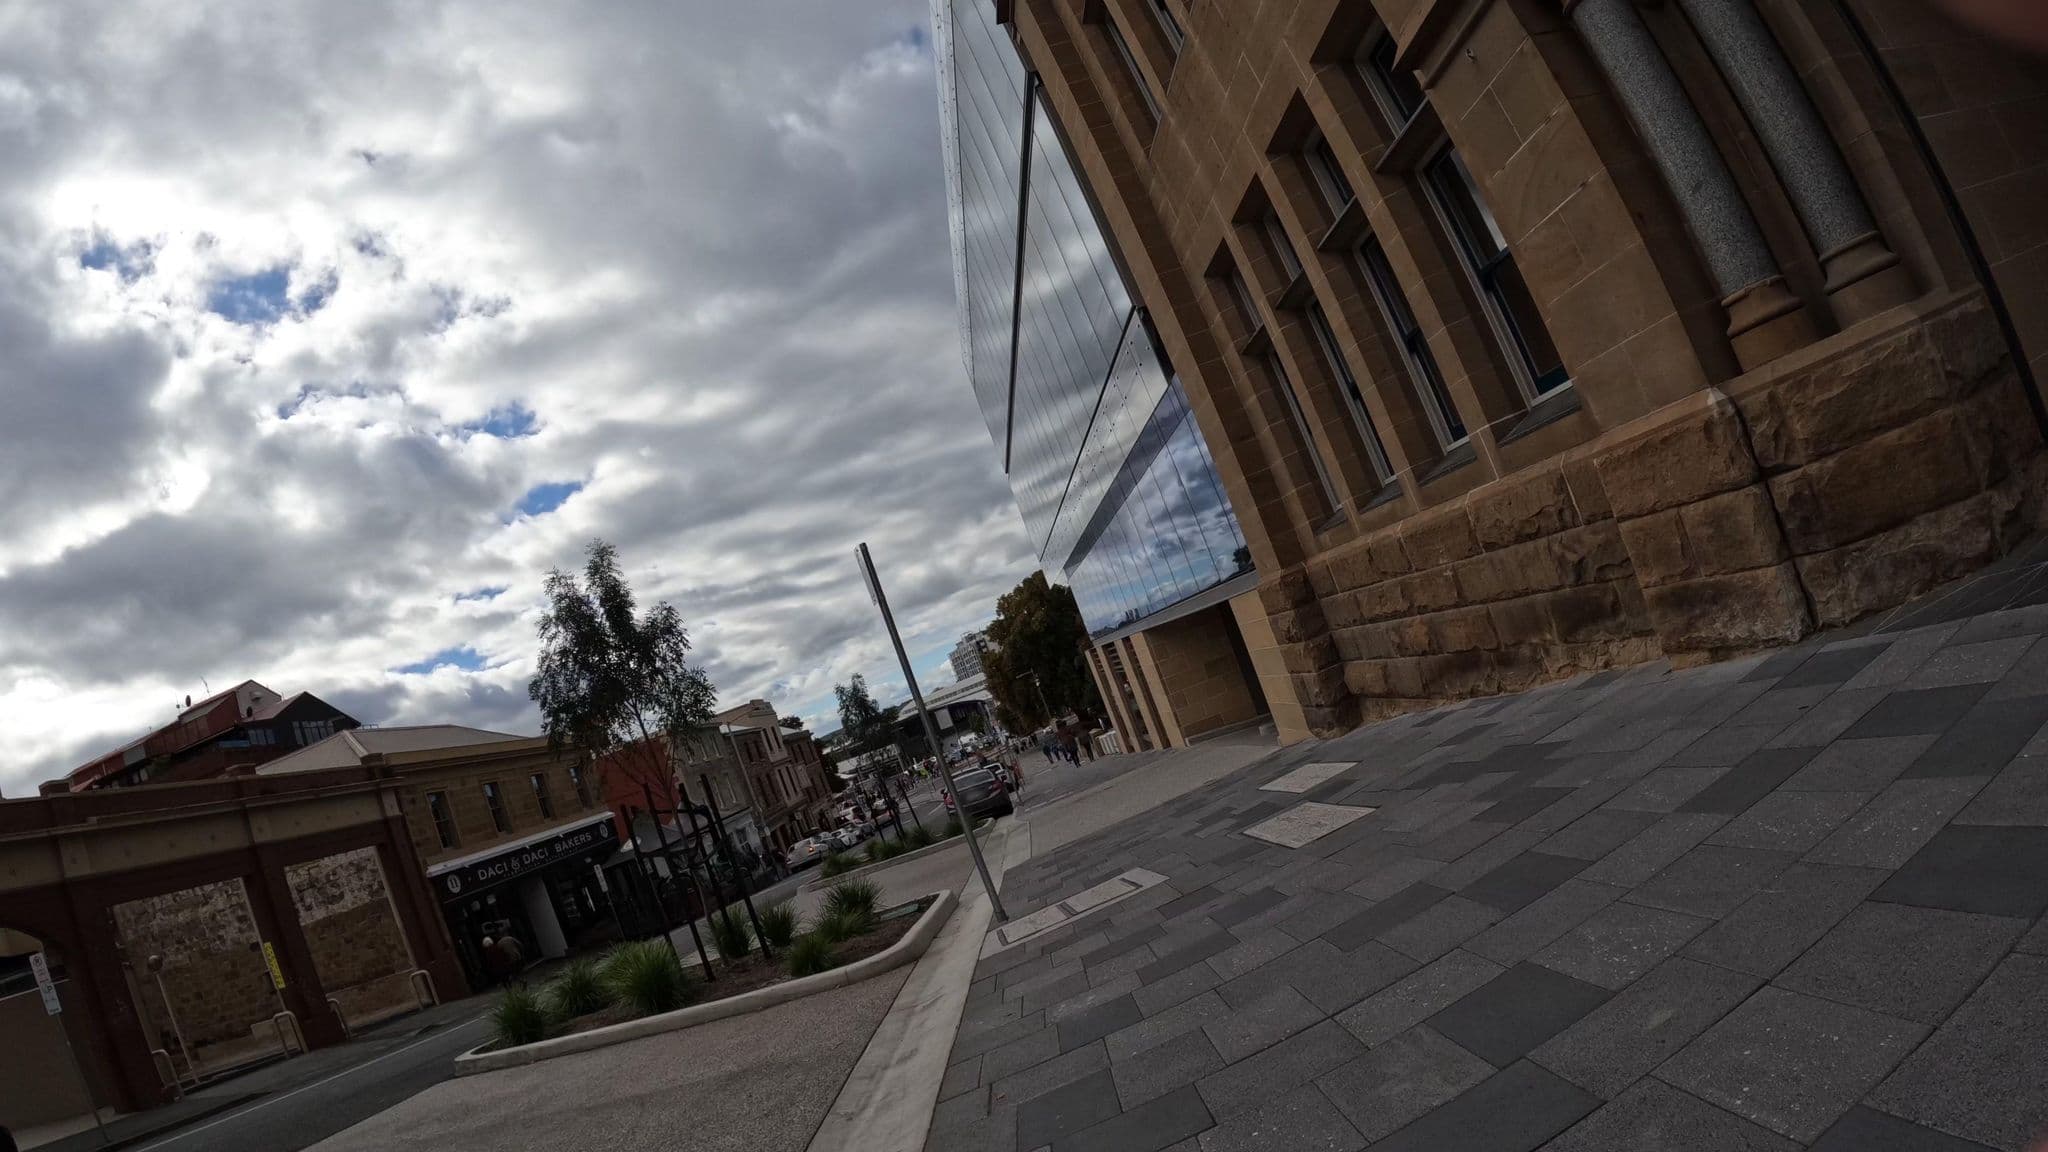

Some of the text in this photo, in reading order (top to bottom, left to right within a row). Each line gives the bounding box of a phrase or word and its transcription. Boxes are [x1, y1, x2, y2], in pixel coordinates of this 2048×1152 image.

[478, 861, 508, 881] DACI
[511, 857, 521, 870] &
[522, 847, 549, 865] DACI
[554, 832, 593, 853] BAKERS
